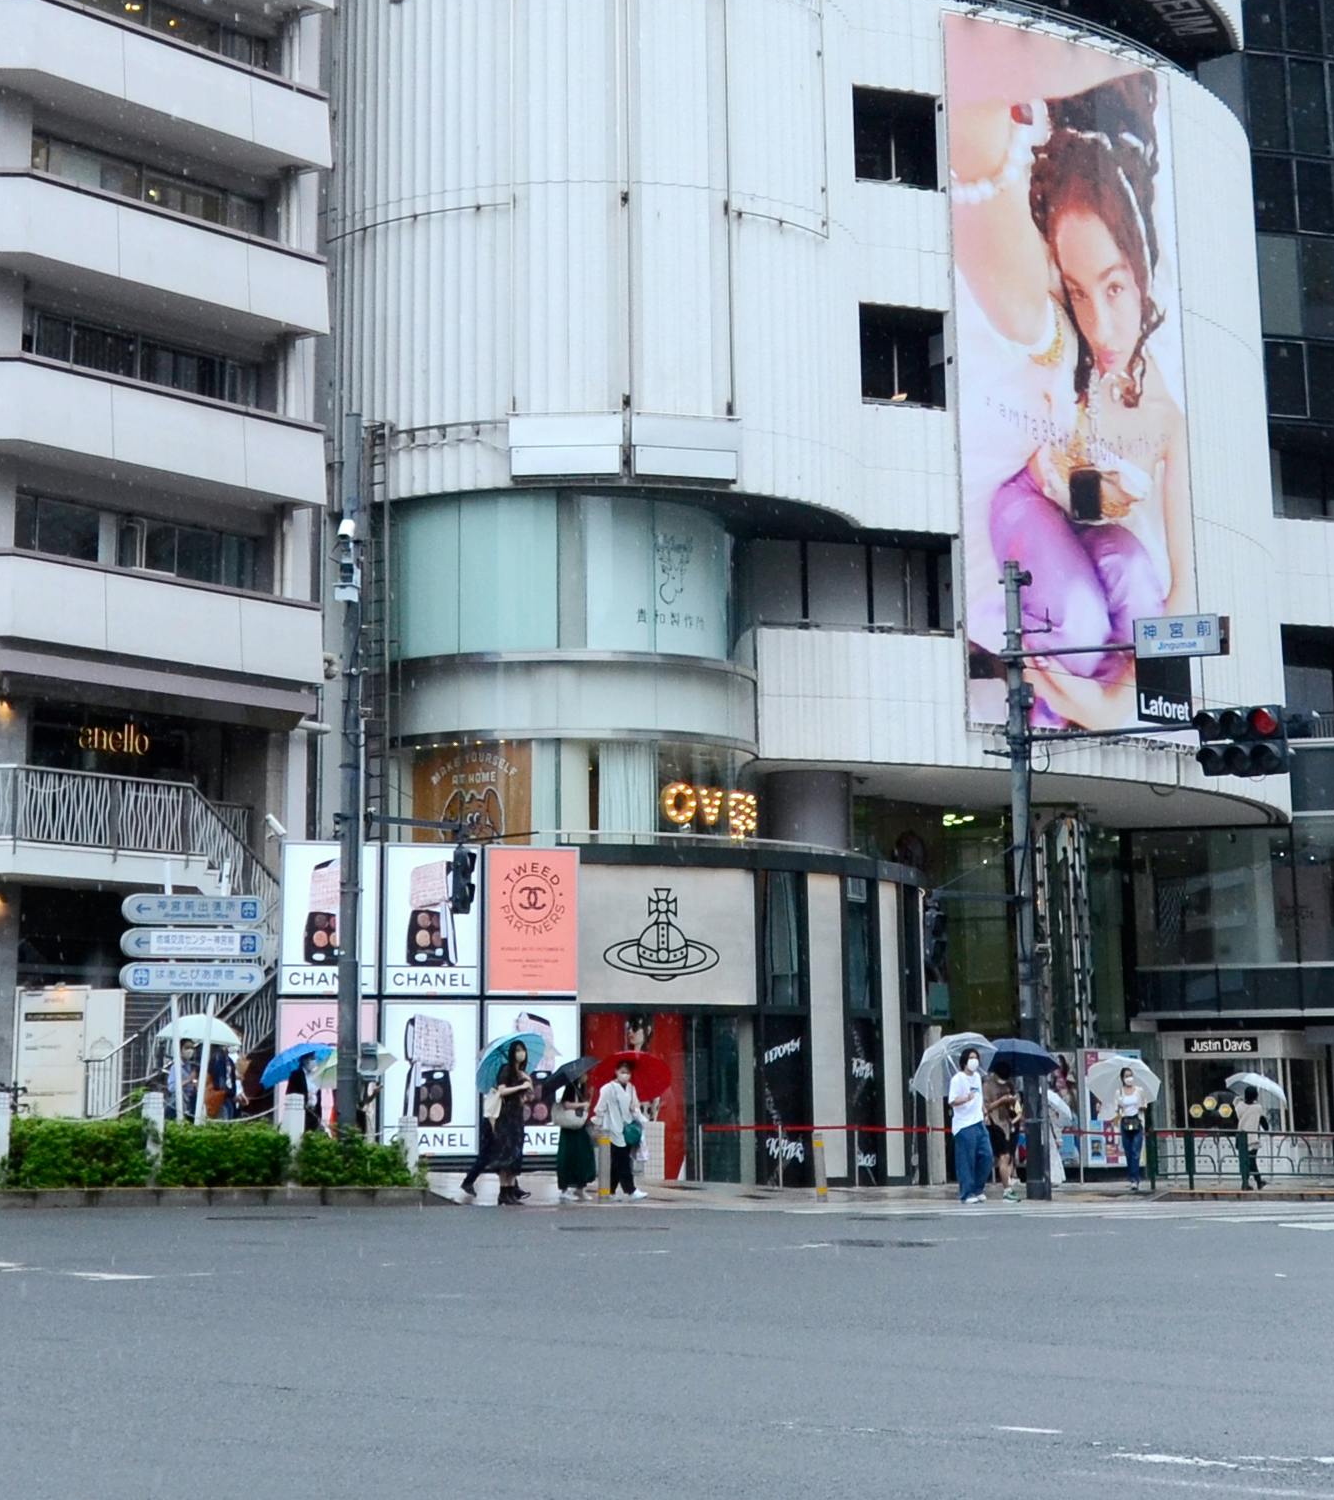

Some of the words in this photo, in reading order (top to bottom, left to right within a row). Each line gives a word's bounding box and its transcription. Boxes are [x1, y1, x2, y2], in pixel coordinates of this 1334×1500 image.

[1143, 620, 1212, 639] 神宮前
[1158, 640, 1197, 651] Jingumae
[1140, 692, 1190, 722] Laforet
[78, 722, 149, 756] anello
[504, 862, 561, 886] TWEED
[500, 903, 566, 936] PARTNERS
[392, 972, 471, 988] CHANEL
[297, 1017, 337, 1040] TWE
[1190, 1037, 1221, 1052] Justin
[1223, 1037, 1252, 1052] Davis
